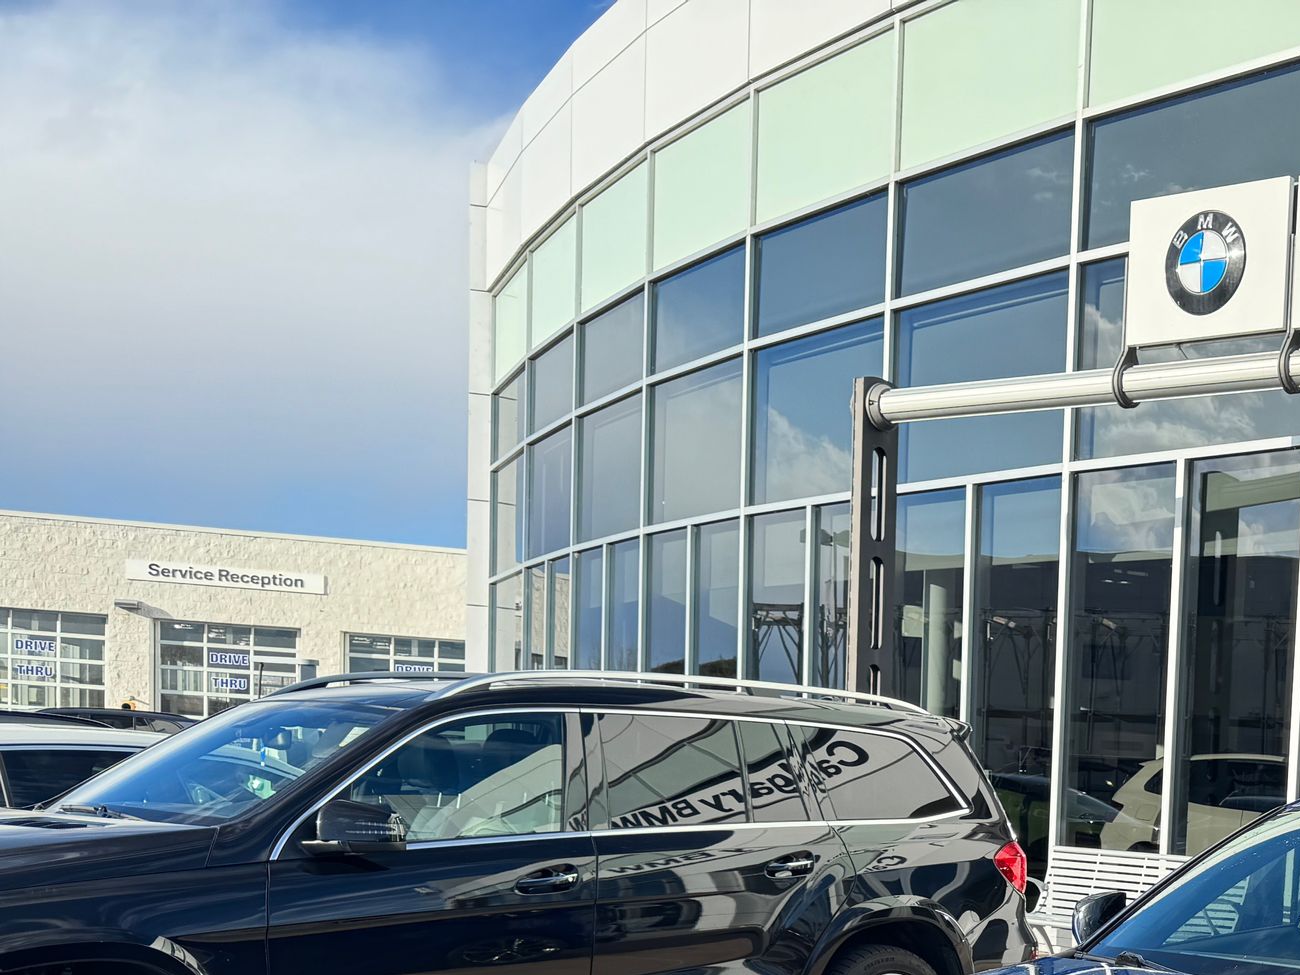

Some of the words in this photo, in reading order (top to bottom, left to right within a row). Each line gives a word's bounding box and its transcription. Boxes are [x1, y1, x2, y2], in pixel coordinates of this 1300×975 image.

[148, 562, 215, 582] Service
[218, 568, 305, 590] Reception
[15, 639, 56, 653] DRIVE
[208, 651, 250, 667] DRIVE
[16, 664, 54, 678] THRU
[211, 676, 248, 691] THRU
